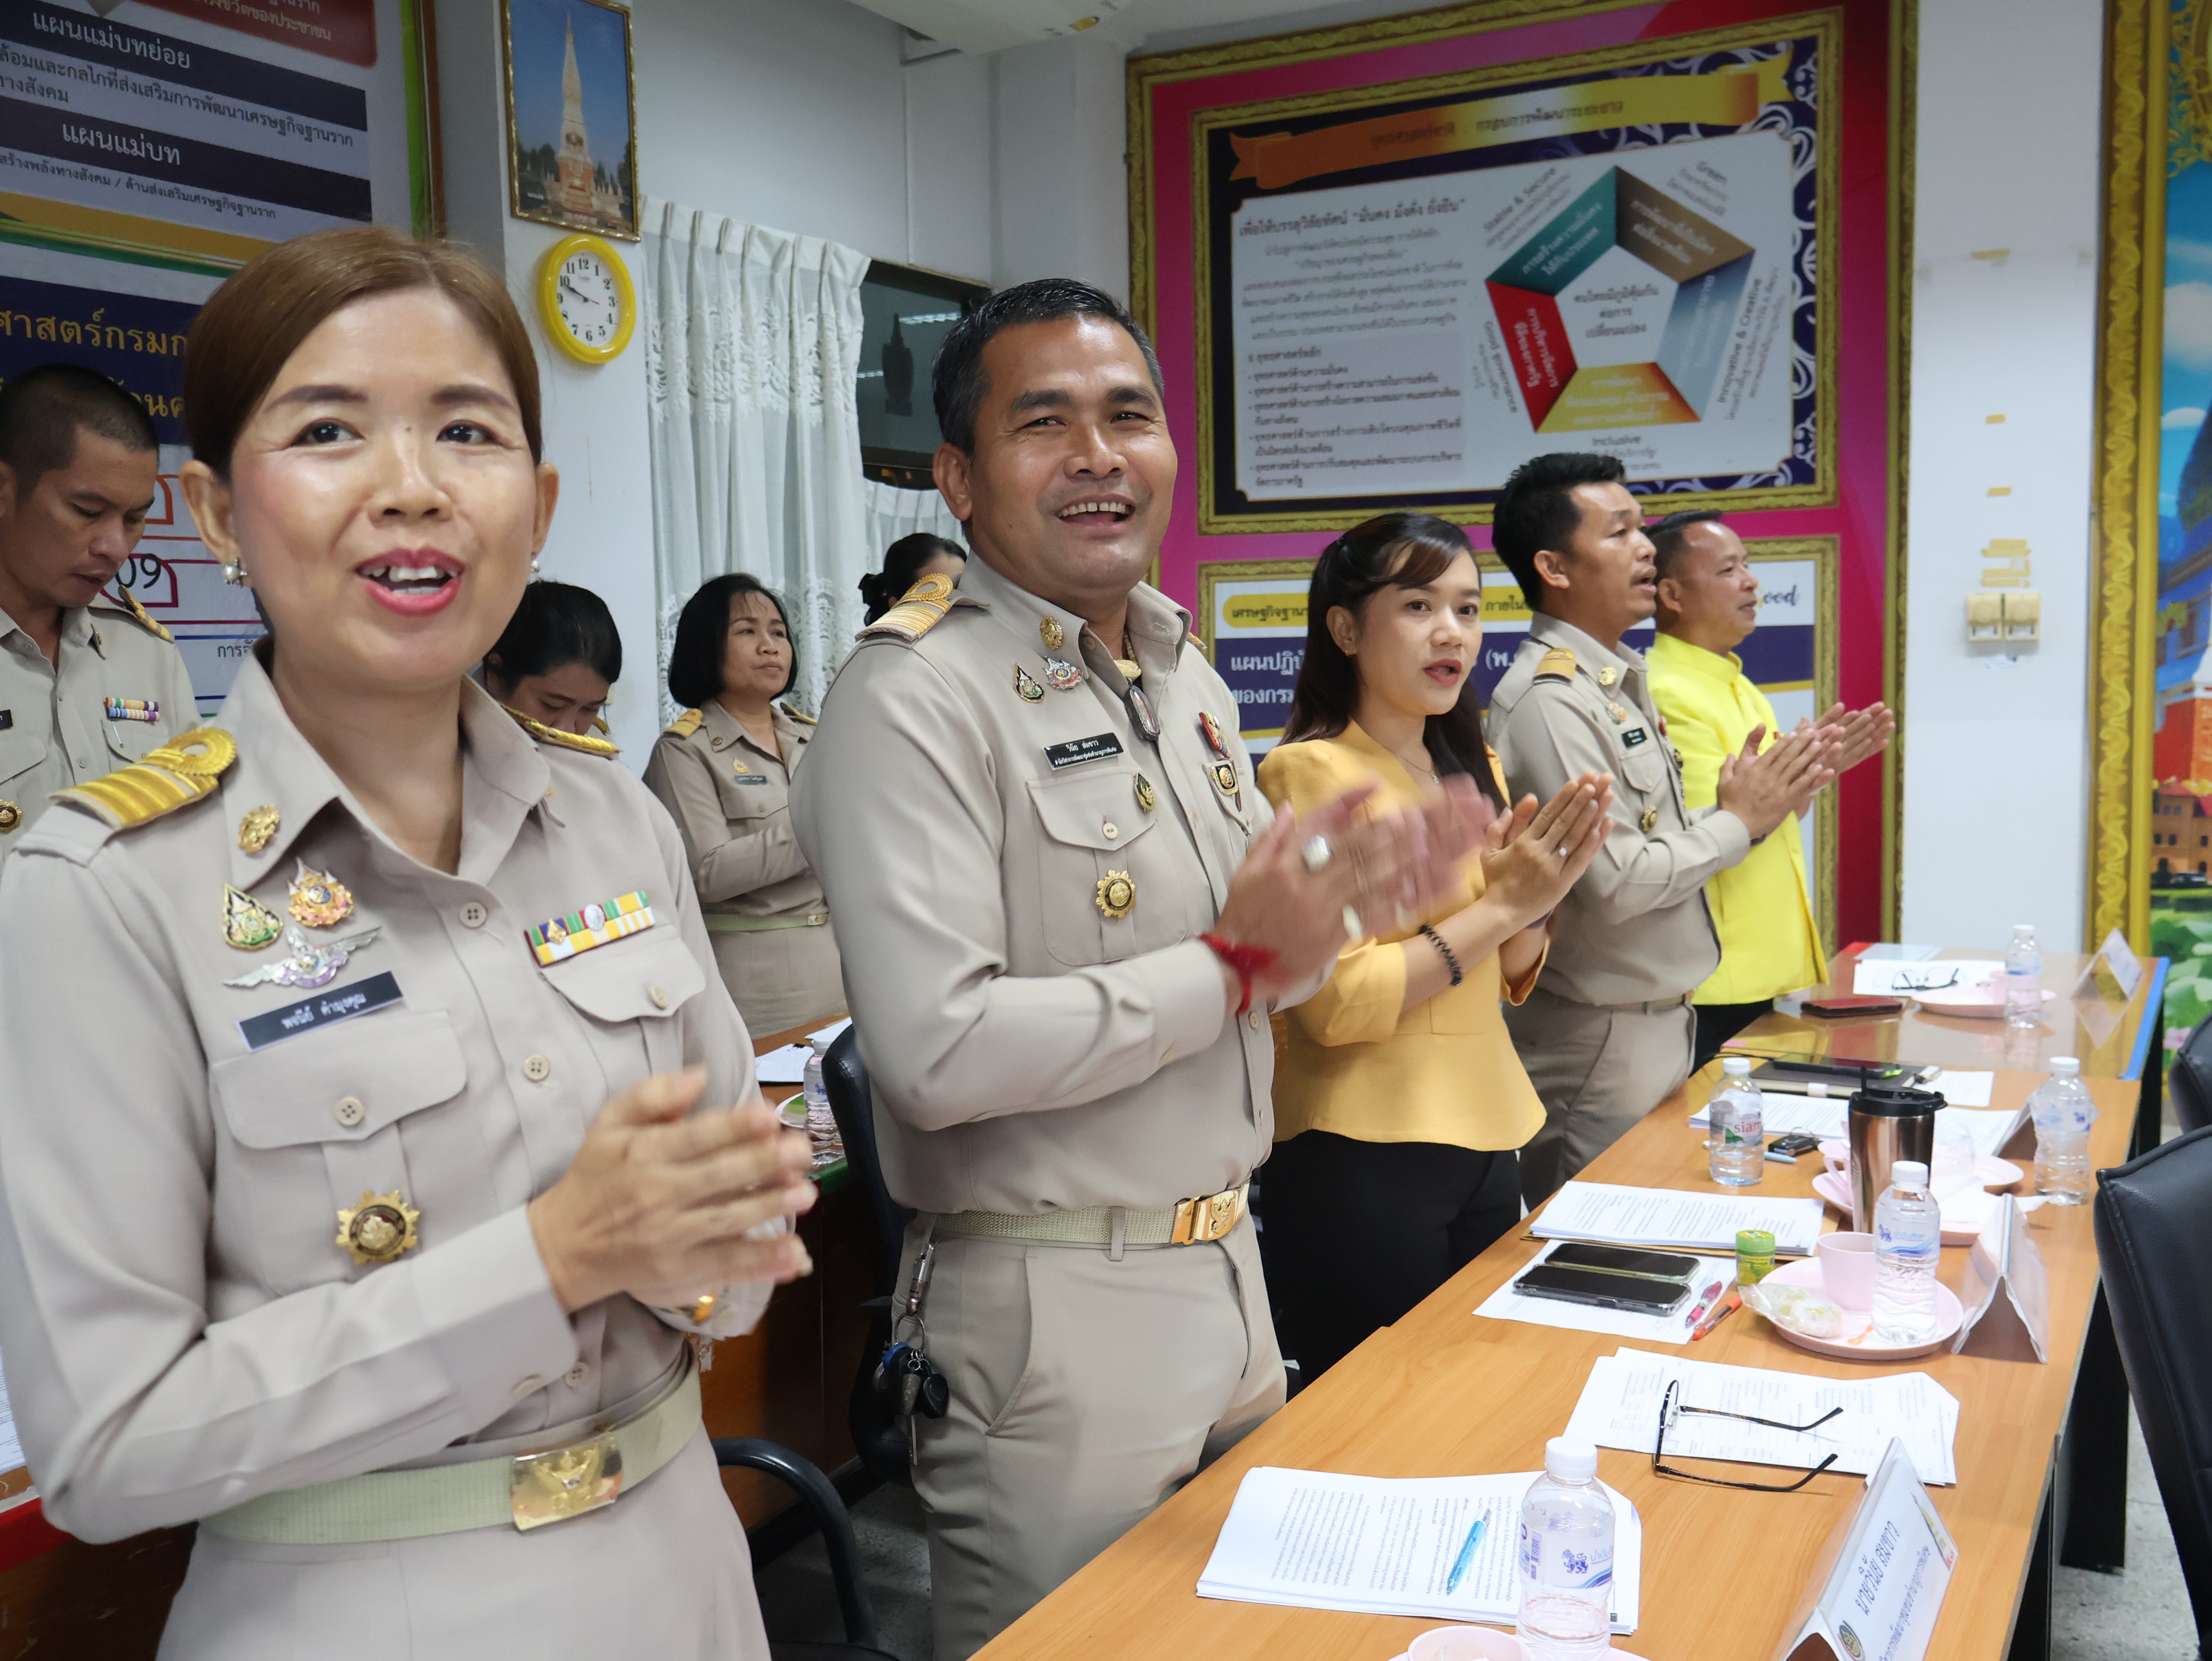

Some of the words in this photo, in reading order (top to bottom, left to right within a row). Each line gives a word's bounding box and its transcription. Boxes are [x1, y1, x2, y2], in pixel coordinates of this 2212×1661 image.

[33, 11, 191, 69] แผนแม่บทย่อย
[62, 122, 181, 166] แผนแม่บท
[566, 262, 575, 274] 11
[579, 258, 589, 270] 12
[595, 265, 599, 276] 1
[559, 275, 570, 287] 10
[603, 279, 612, 290] 2
[609, 296, 615, 308] 3
[606, 313, 613, 325] 4
[572, 324, 578, 335] 7
[599, 325, 605, 337] 5
[586, 330, 592, 342] 6
[1484, 321, 1501, 360] Good
[1592, 433, 1641, 447] Inclusive
[1485, 595, 1527, 611] ภายใน
[1485, 649, 1517, 671] (พ.
[1855, 1553, 1884, 1616] นายวินัย
